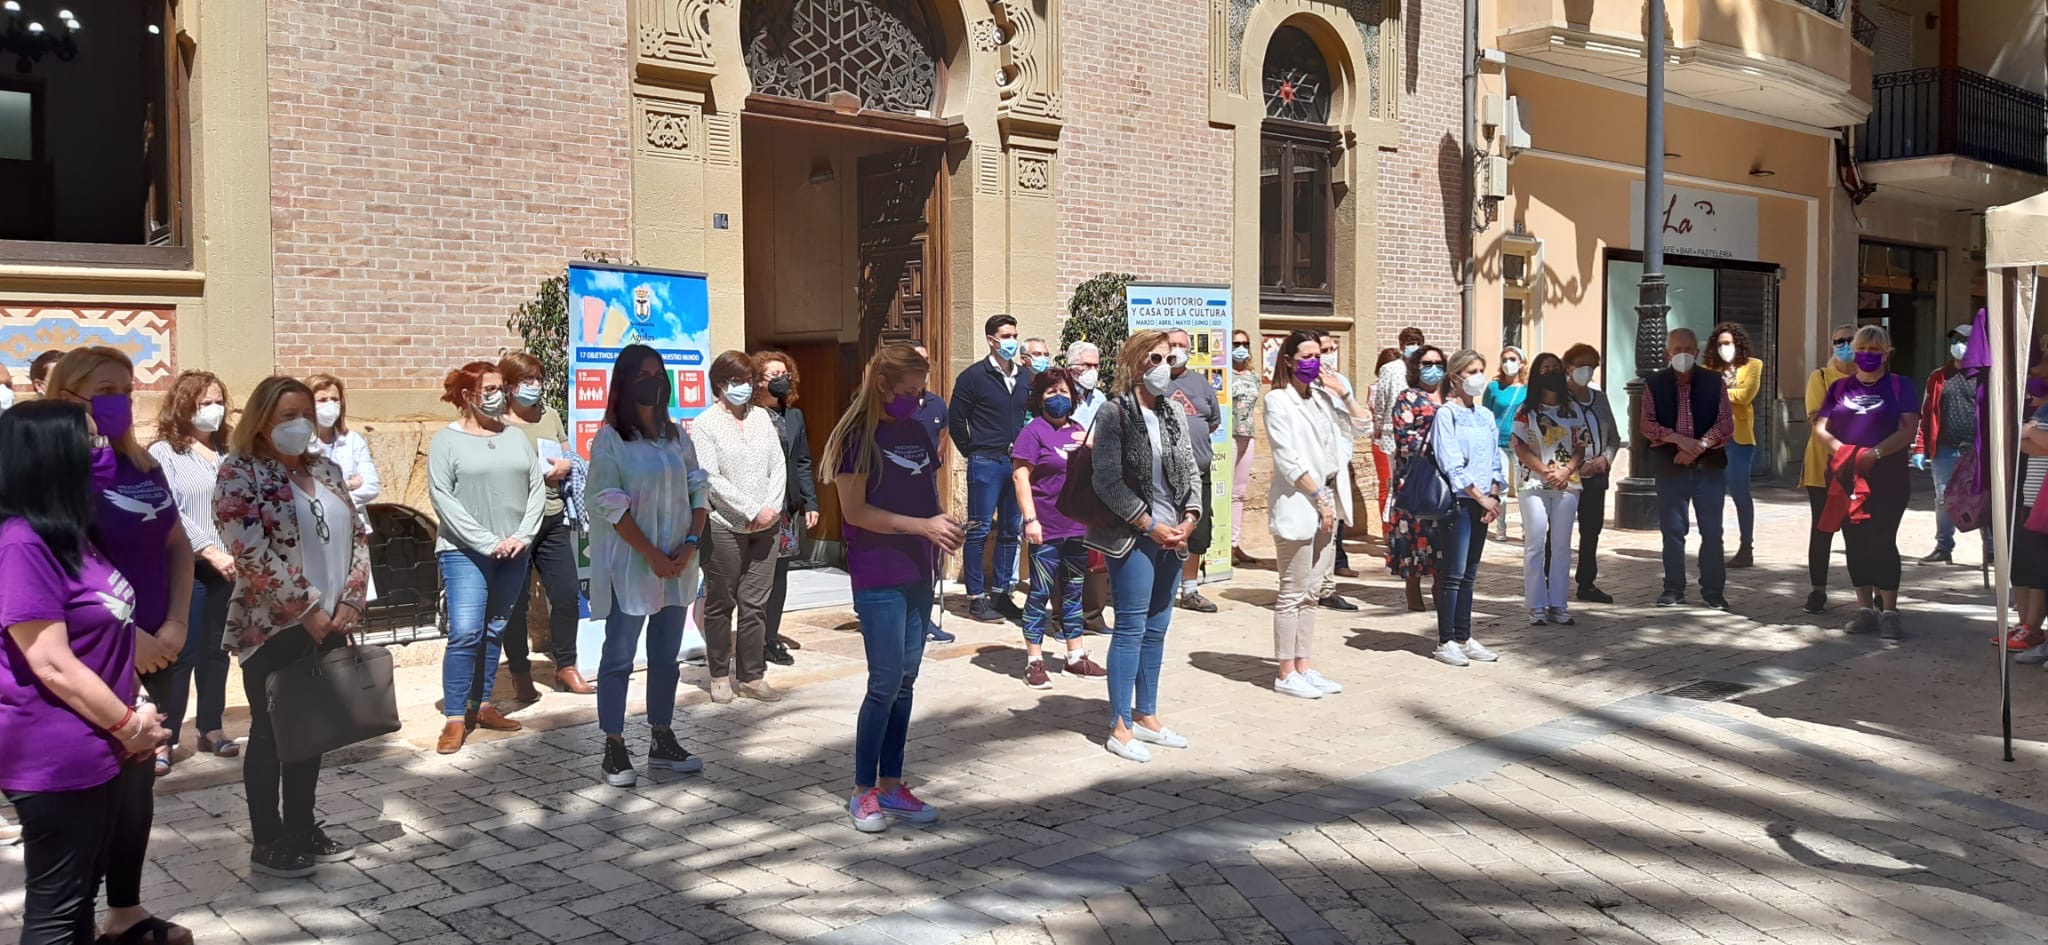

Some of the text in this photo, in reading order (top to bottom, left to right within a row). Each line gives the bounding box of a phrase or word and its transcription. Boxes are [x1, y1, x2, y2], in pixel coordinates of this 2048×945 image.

[1680, 247, 1693, 256] BAR
[1155, 296, 1204, 306] AUDITORIO
[1131, 307, 1226, 318] Y CASA DE LA CULTURA
